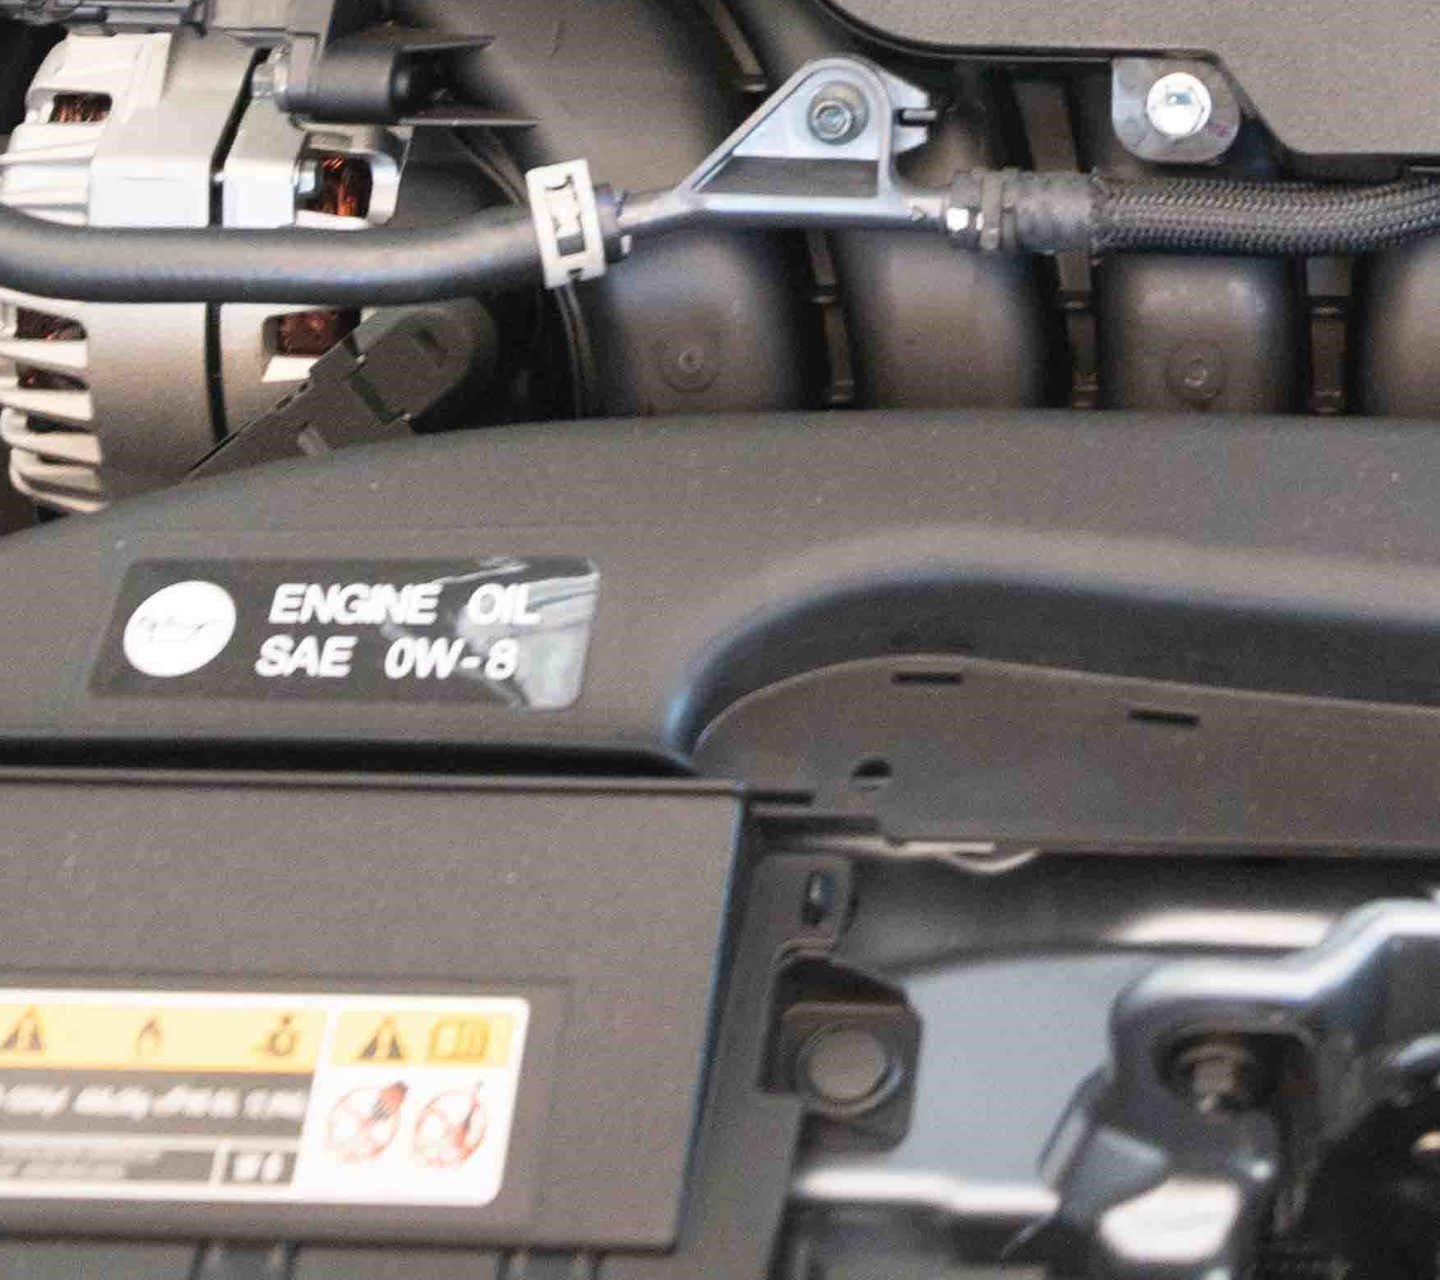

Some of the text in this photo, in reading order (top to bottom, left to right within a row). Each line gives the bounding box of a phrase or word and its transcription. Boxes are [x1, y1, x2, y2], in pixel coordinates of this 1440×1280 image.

[268, 582, 541, 625] ENGINE OIL
[255, 634, 521, 680] SAE 0W-8
